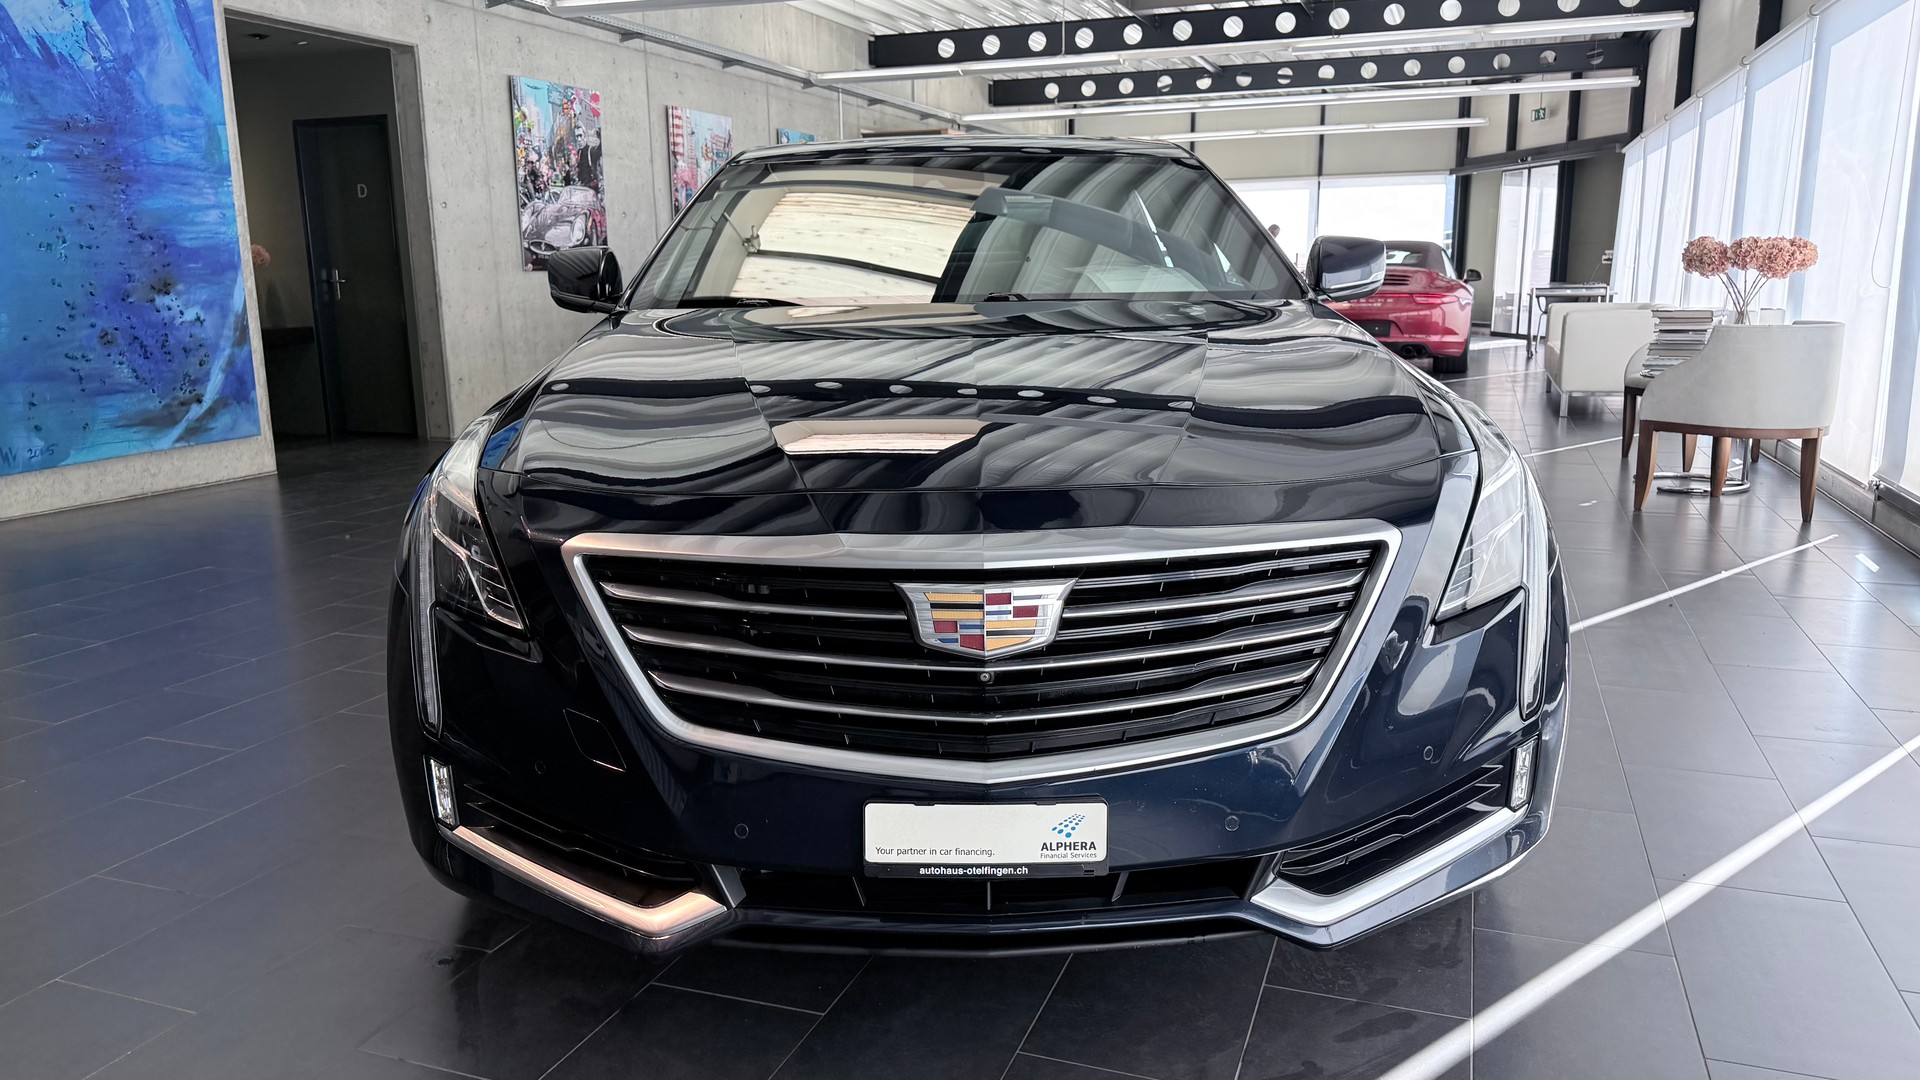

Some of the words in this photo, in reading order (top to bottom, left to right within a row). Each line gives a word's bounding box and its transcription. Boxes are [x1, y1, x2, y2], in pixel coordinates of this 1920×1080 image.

[357, 183, 368, 198] D
[875, 846, 895, 855] Your
[896, 846, 927, 857] partner
[929, 847, 937, 856] in
[939, 848, 952, 856] car
[954, 847, 995, 858] financing.
[1040, 841, 1097, 852] ALPHERA
[1070, 851, 1098, 859] Services
[919, 866, 1029, 877] autohaus-otelfingen.ch
